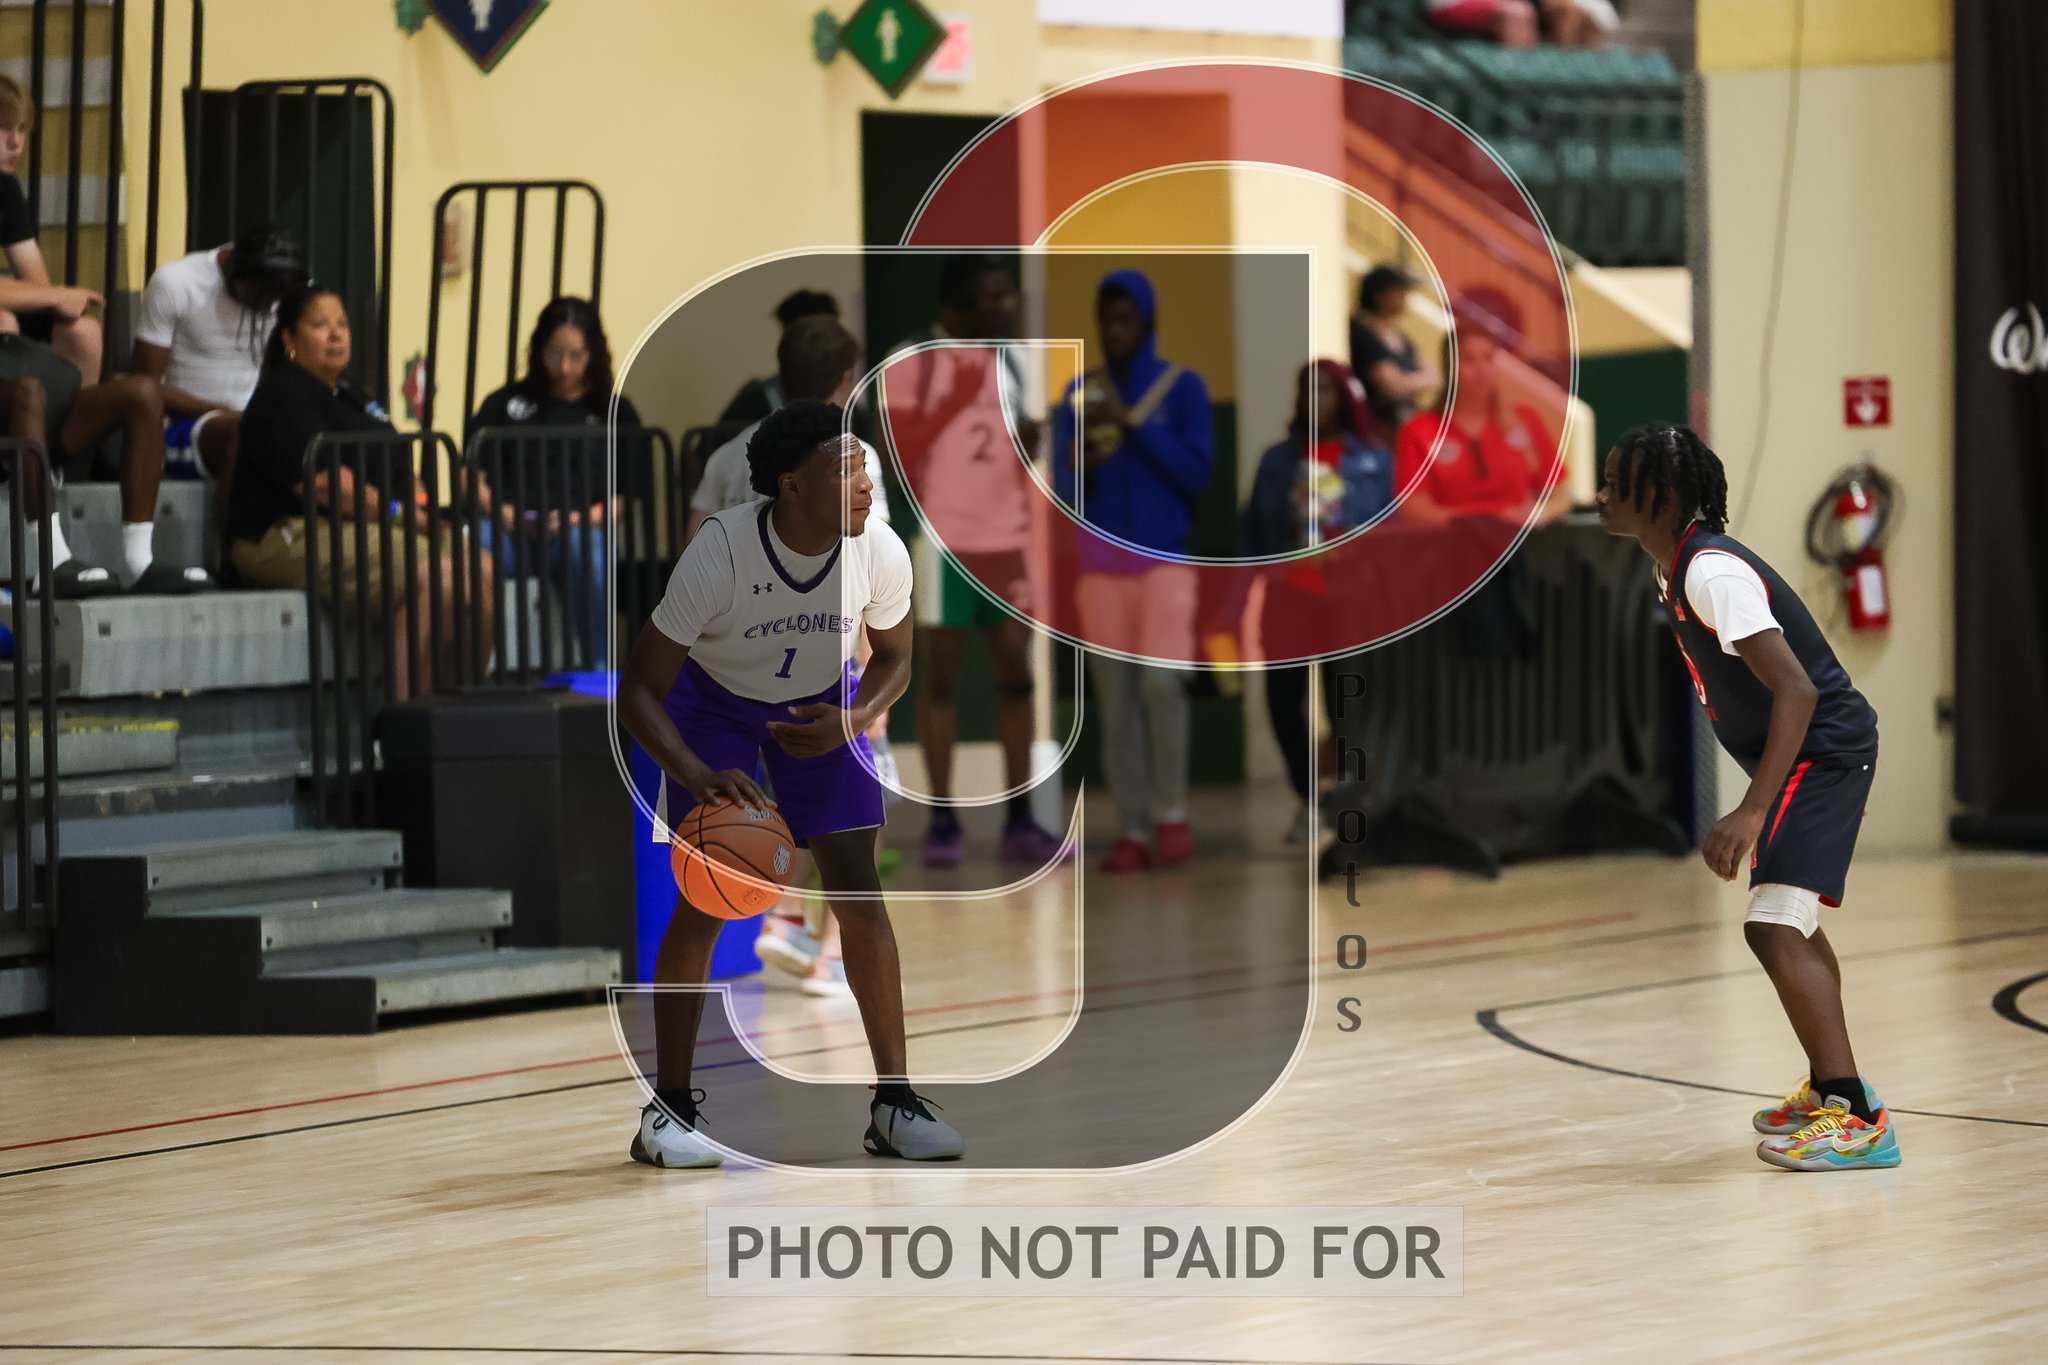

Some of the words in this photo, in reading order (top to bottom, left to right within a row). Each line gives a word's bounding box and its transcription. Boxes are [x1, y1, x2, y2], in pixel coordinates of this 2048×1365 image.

[969, 423, 994, 462] 2
[744, 612, 854, 639] CYCLONES
[775, 648, 797, 679] 1
